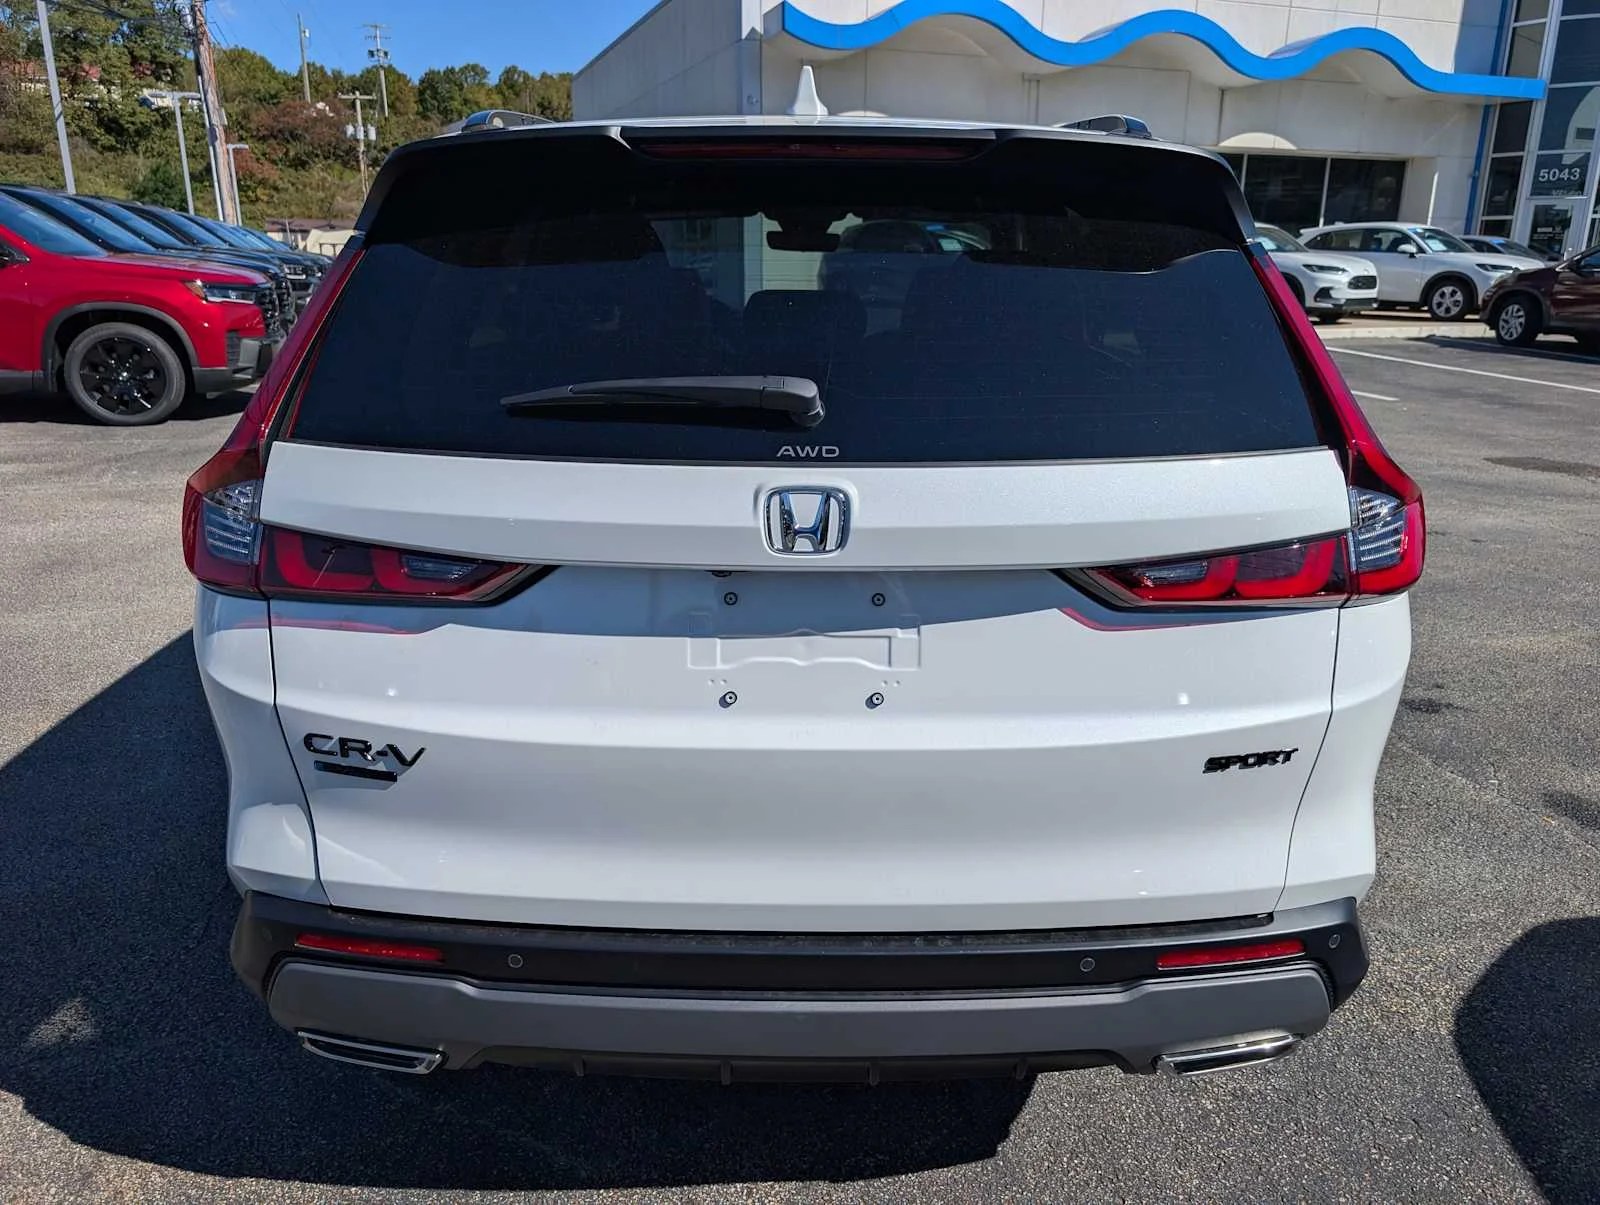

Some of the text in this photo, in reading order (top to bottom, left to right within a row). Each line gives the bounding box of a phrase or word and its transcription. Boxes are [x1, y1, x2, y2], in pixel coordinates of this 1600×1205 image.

[1538, 167, 1581, 182] 5043
[776, 445, 840, 458] AWD
[303, 732, 426, 767] CR-V
[1202, 747, 1299, 774] SPORT
